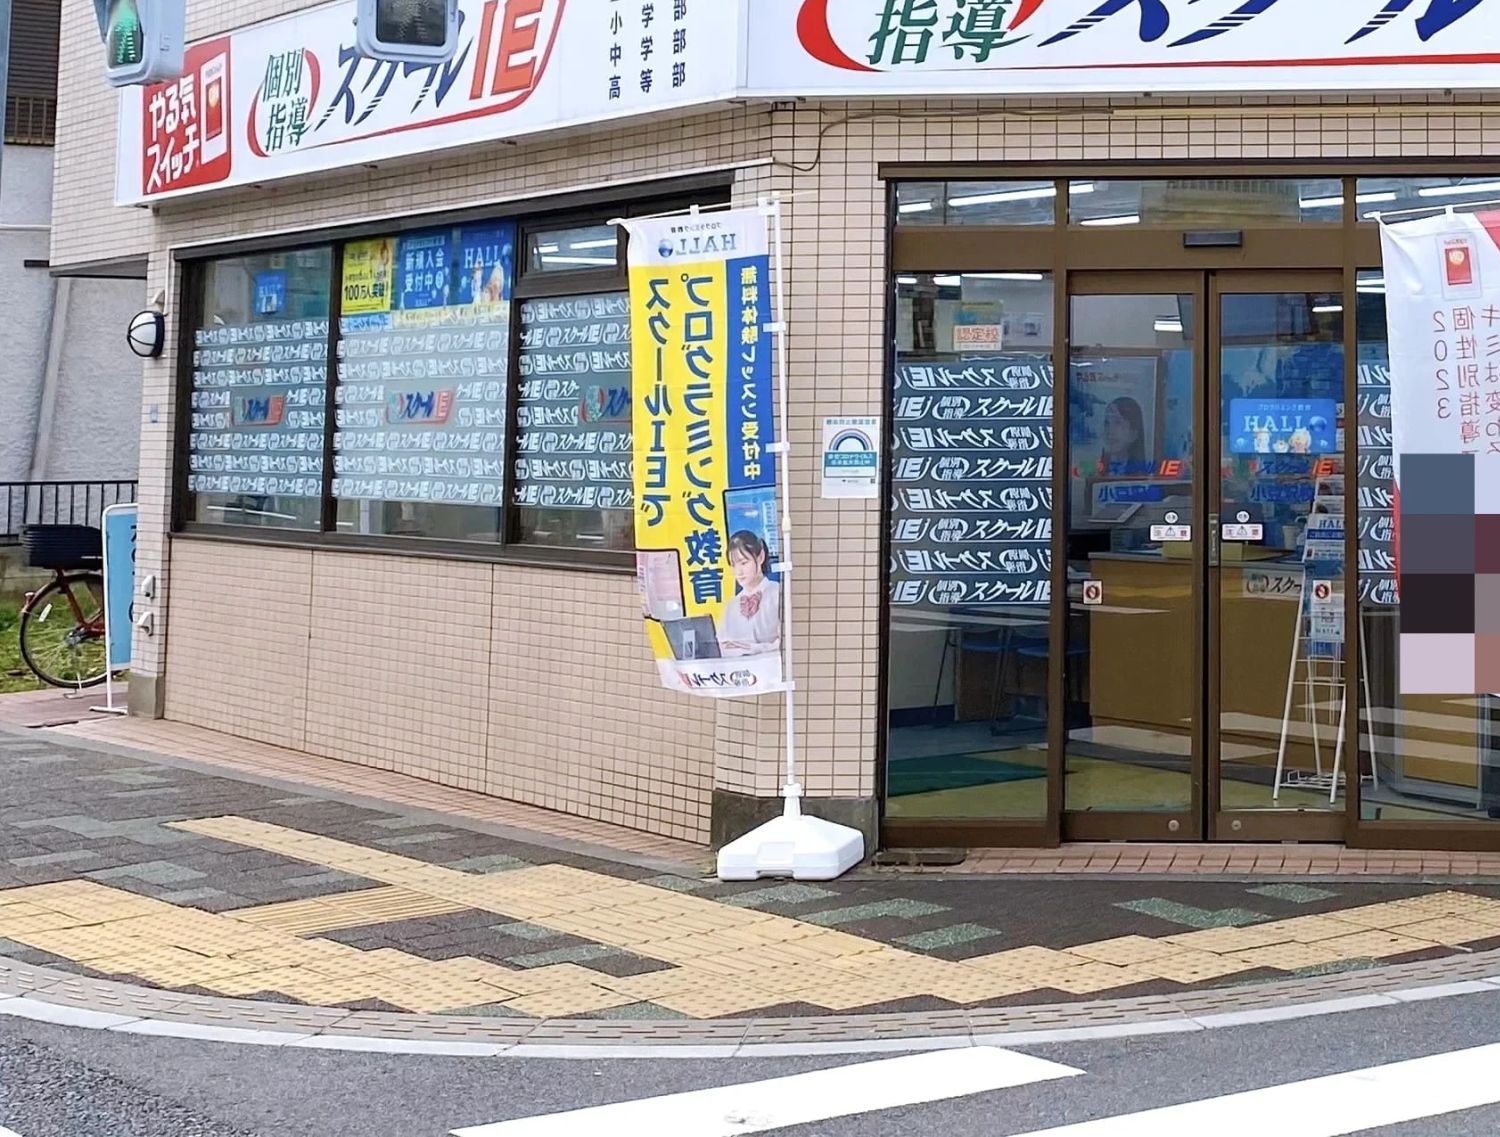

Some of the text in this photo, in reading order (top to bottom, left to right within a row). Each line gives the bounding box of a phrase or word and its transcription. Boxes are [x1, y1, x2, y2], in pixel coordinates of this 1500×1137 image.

[263, 48, 305, 102] 個別
[149, 75, 197, 142] やる気
[266, 97, 314, 152] 指導
[147, 127, 199, 193] スイッチ
